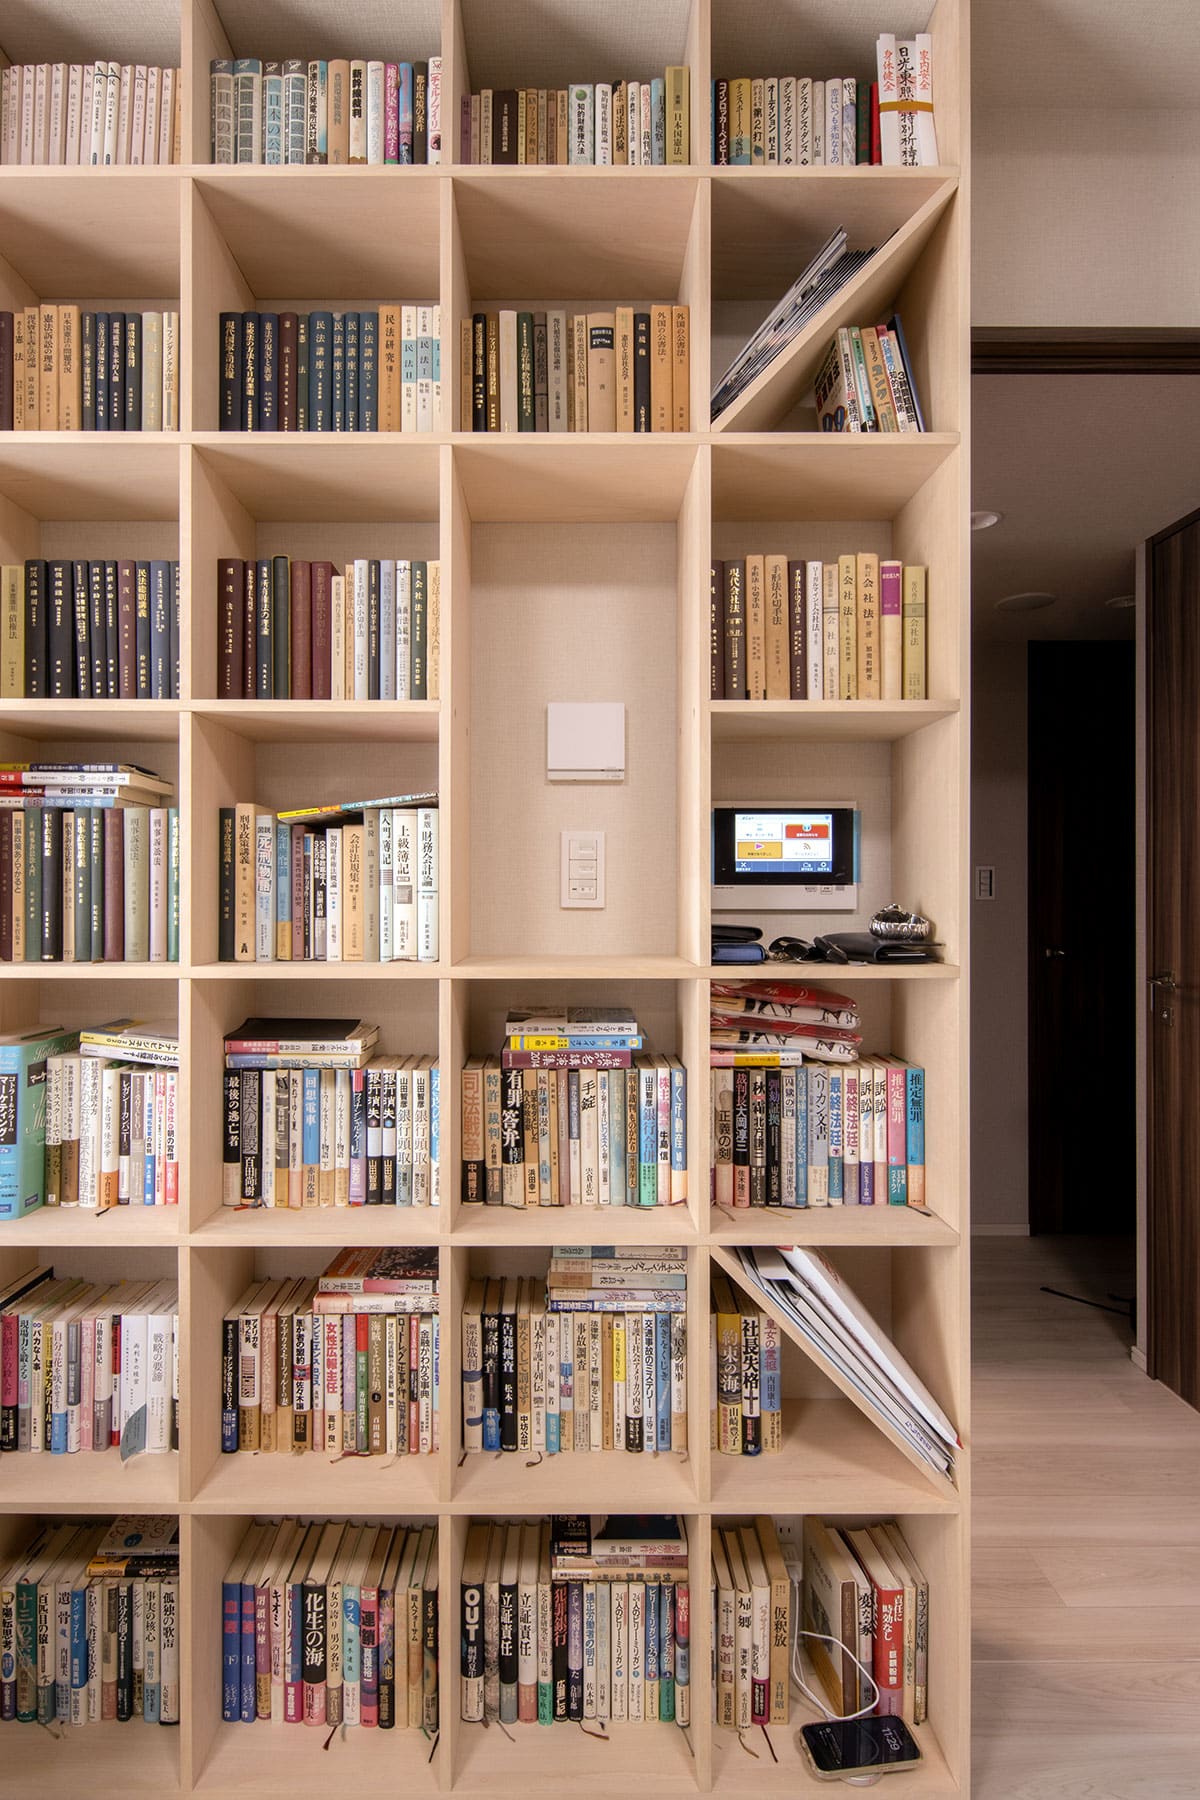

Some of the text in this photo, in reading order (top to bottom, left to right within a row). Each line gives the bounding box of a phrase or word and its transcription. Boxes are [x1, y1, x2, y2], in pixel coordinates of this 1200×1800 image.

[352, 69, 362, 119] 新幹線裁判
[882, 49, 895, 91] 身体健全
[919, 50, 930, 90] 家内安全
[576, 103, 585, 155] 知的財産権六法
[616, 107, 625, 152] 司法試験
[674, 113, 682, 155] 日本国憲法
[768, 84, 776, 160] オーディション 村上龍
[784, 82, 794, 153] ダンス・ダンス・ダンス
[800, 82, 810, 153] ダンス・ダンス・ダンス
[831, 88, 840, 163] 恋はいつも未知なもの
[43, 314, 53, 373] 憲法訴訟の理論
[63, 312, 72, 374] 日本国憲法の問題状況
[316, 320, 326, 380] 民法講座4
[334, 320, 343, 380] 民法講座3
[348, 320, 357, 380] 民法講座2
[363, 320, 373, 380] 民法講座5
[385, 314, 396, 363] 民法研究
[729, 568, 740, 614] 現代会社法
[771, 564, 782, 626] 手形法小切手法
[811, 566, 819, 632] リーガルマインド会社法
[843, 574, 853, 617] 会社法
[863, 578, 874, 619] 会社法
[826, 616, 836, 656] 会社法
[910, 618, 919, 646] 会社法
[349, 833, 359, 883] 会計法規集
[397, 826, 410, 875] 上級簿記
[423, 830, 433, 887] 財務会計論
[106, 1037, 128, 1045] 2020
[530, 1052, 594, 1068] 名講演集 2014
[53, 1069, 62, 1144] ビジネススクールでは
[228, 1075, 240, 1147] 最後の逃亡者
[368, 1072, 381, 1120] 銀行消失
[383, 1072, 396, 1120] 銀行消失
[464, 1072, 481, 1158] 司法戦争
[486, 1073, 500, 1141] 特許 裁判
[502, 1070, 524, 1148] 有罪答弁
[581, 1079, 596, 1112] 手錠
[628, 1074, 637, 1153] 刑事裁判ものがたり
[736, 1073, 747, 1108] 裁判長
[815, 1068, 828, 1140] ペリカン文書
[830, 1077, 842, 1147] 最終法廷
[846, 1077, 858, 1148] 最終法廷
[860, 1079, 872, 1114] 訴訟
[875, 1079, 887, 1114] 訴訟
[891, 1074, 904, 1124] 推定無罪
[909, 1073, 922, 1124] 推定無罪
[243, 1073, 257, 1198] 野良犬の値段 百田尚樹
[305, 1076, 317, 1200] 回想電車 赤川次郎
[397, 1077, 411, 1164] 山田智彦 銀行頭取
[414, 1077, 427, 1164] 山田智彦 銀行頭取
[643, 1077, 656, 1164] 山田智彦 銀行合併
[660, 1131, 669, 1161] 牛島 信
[718, 1110, 731, 1160] 正義の剣
[527, 1168, 537, 1194] 浜田幸一
[20, 1320, 29, 1380] 現場力を鍛える
[33, 1330, 41, 1371] バカな人事
[152, 1333, 164, 1383] 戦略の要諦
[251, 1318, 259, 1349] アメリカを
[371, 1321, 381, 1391] 海賊とよばれた男
[466, 1323, 478, 1371] 漂流裁判
[484, 1316, 498, 1374] 検察捜査
[502, 1321, 514, 1374] 告発捜査
[534, 1320, 544, 1393] 日本弁護士列伝
[547, 1319, 555, 1405] 路上の幸福者
[576, 1323, 587, 1372] 事故調査
[742, 1318, 759, 1390] 社長失格
[54, 1331, 63, 1411] 自分の花を咲かせよう
[296, 1319, 305, 1410] 愚か者の盟約 佐々木譲
[326, 1322, 338, 1443] 女性広報主任 高杉 良
[420, 1329, 430, 1399] 金融がわかる事典
[518, 1319, 529, 1448] 罪なくして罰せず 中坊公平
[645, 1319, 654, 1408] 交通事故のミステリー
[722, 1328, 739, 1446] 約束の海 山崎豊子
[765, 1318, 777, 1409] 皇女の霊柩 内田康夫
[641, 1543, 681, 1554] 別離の条件
[58, 1591, 71, 1625] 遺骨
[72, 1597, 80, 1645] イン・ザ・プール
[145, 1591, 156, 1643] 事実の核心
[162, 1591, 175, 1649] 孤独の歌声
[256, 1594, 266, 1645] 閉鎖病棟
[272, 1590, 282, 1628] キオミ
[305, 1592, 325, 1667] 化生の海
[360, 1610, 376, 1646] 連鎖
[464, 1588, 480, 1678] OUT 桐野夏生
[500, 1592, 512, 1658] 立証責任
[520, 1592, 532, 1658] 立証責任
[615, 1594, 624, 1670] 24人のビリー・ミリガン
[632, 1594, 641, 1670] 24人のビリー・ミリガン
[738, 1597, 753, 1630] 帰郷
[859, 1592, 873, 1638] 変な家
[882, 1604, 893, 1643] 時効なし
[893, 1594, 903, 1624] 責任に
[719, 1634, 734, 1686] 鉄道員
[774, 1605, 787, 1711] 仮釈放 吉村昭
[880, 1726, 902, 1752] 11:29
